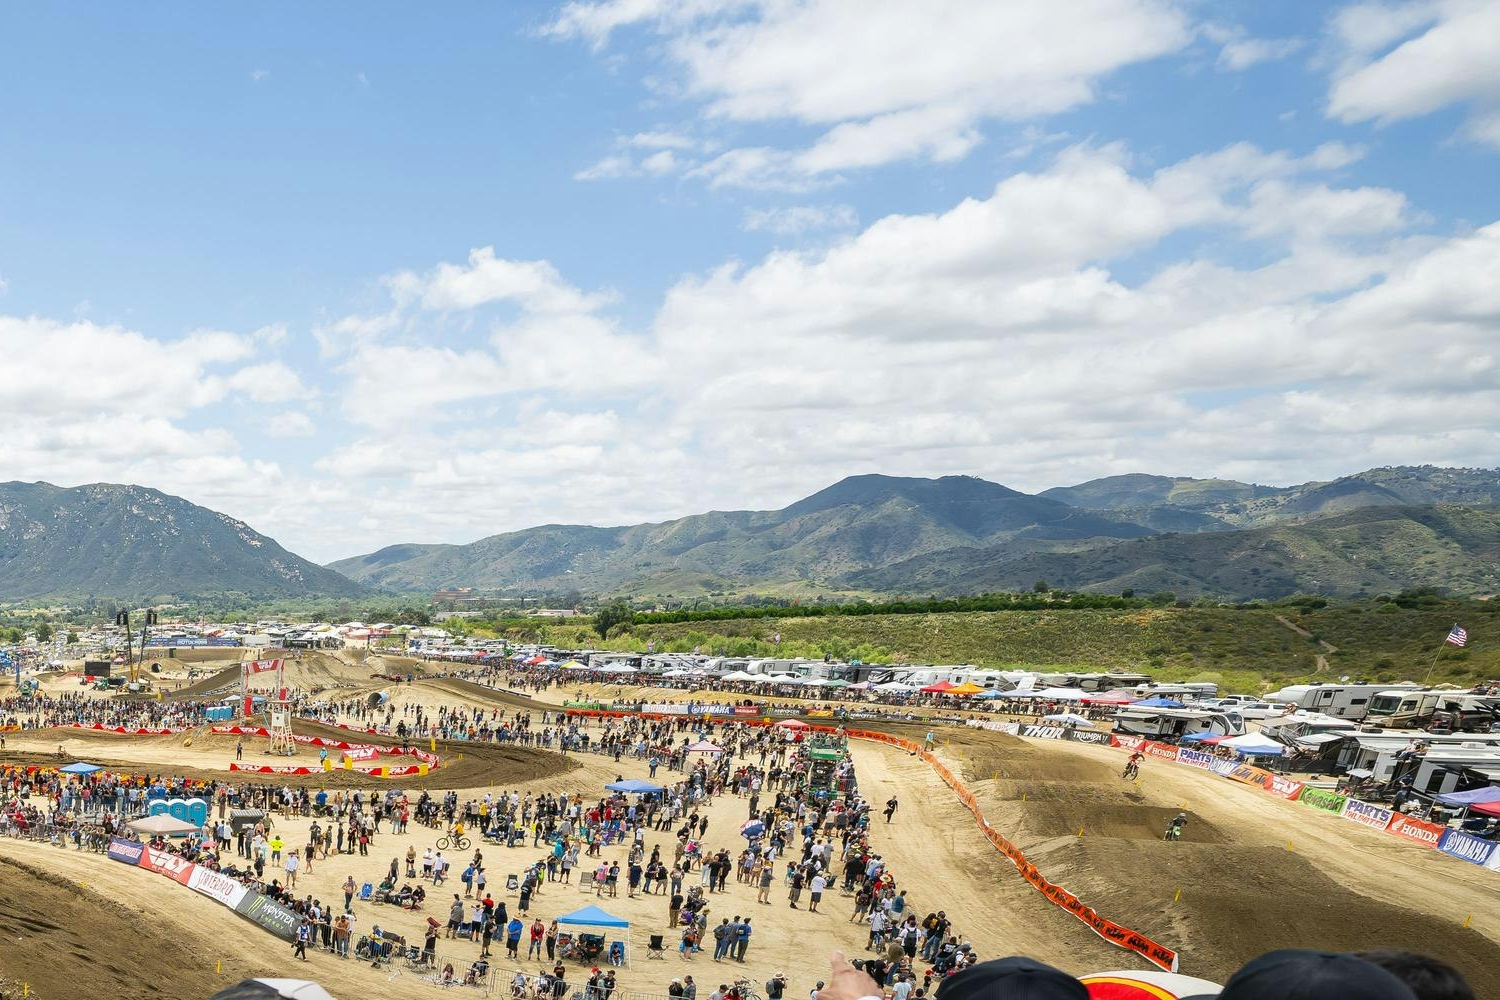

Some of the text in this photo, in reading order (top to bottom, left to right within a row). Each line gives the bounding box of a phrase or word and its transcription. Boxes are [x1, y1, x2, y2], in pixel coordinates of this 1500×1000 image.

[700, 706, 730, 714] YAMAHA
[1023, 725, 1065, 739] THOR
[1073, 731, 1102, 742] TRIUMPH
[343, 748, 375, 758] FLY
[1152, 747, 1176, 759] HONDA
[1180, 749, 1212, 763] PARTS
[1272, 775, 1302, 794] FLY
[1301, 788, 1346, 812] Kawasaki
[1347, 800, 1390, 822] PARTS
[1401, 823, 1439, 844] HONDA
[1453, 834, 1491, 862] YAMAHA
[148, 847, 193, 874] FLY
[262, 903, 295, 927] MONSTER
